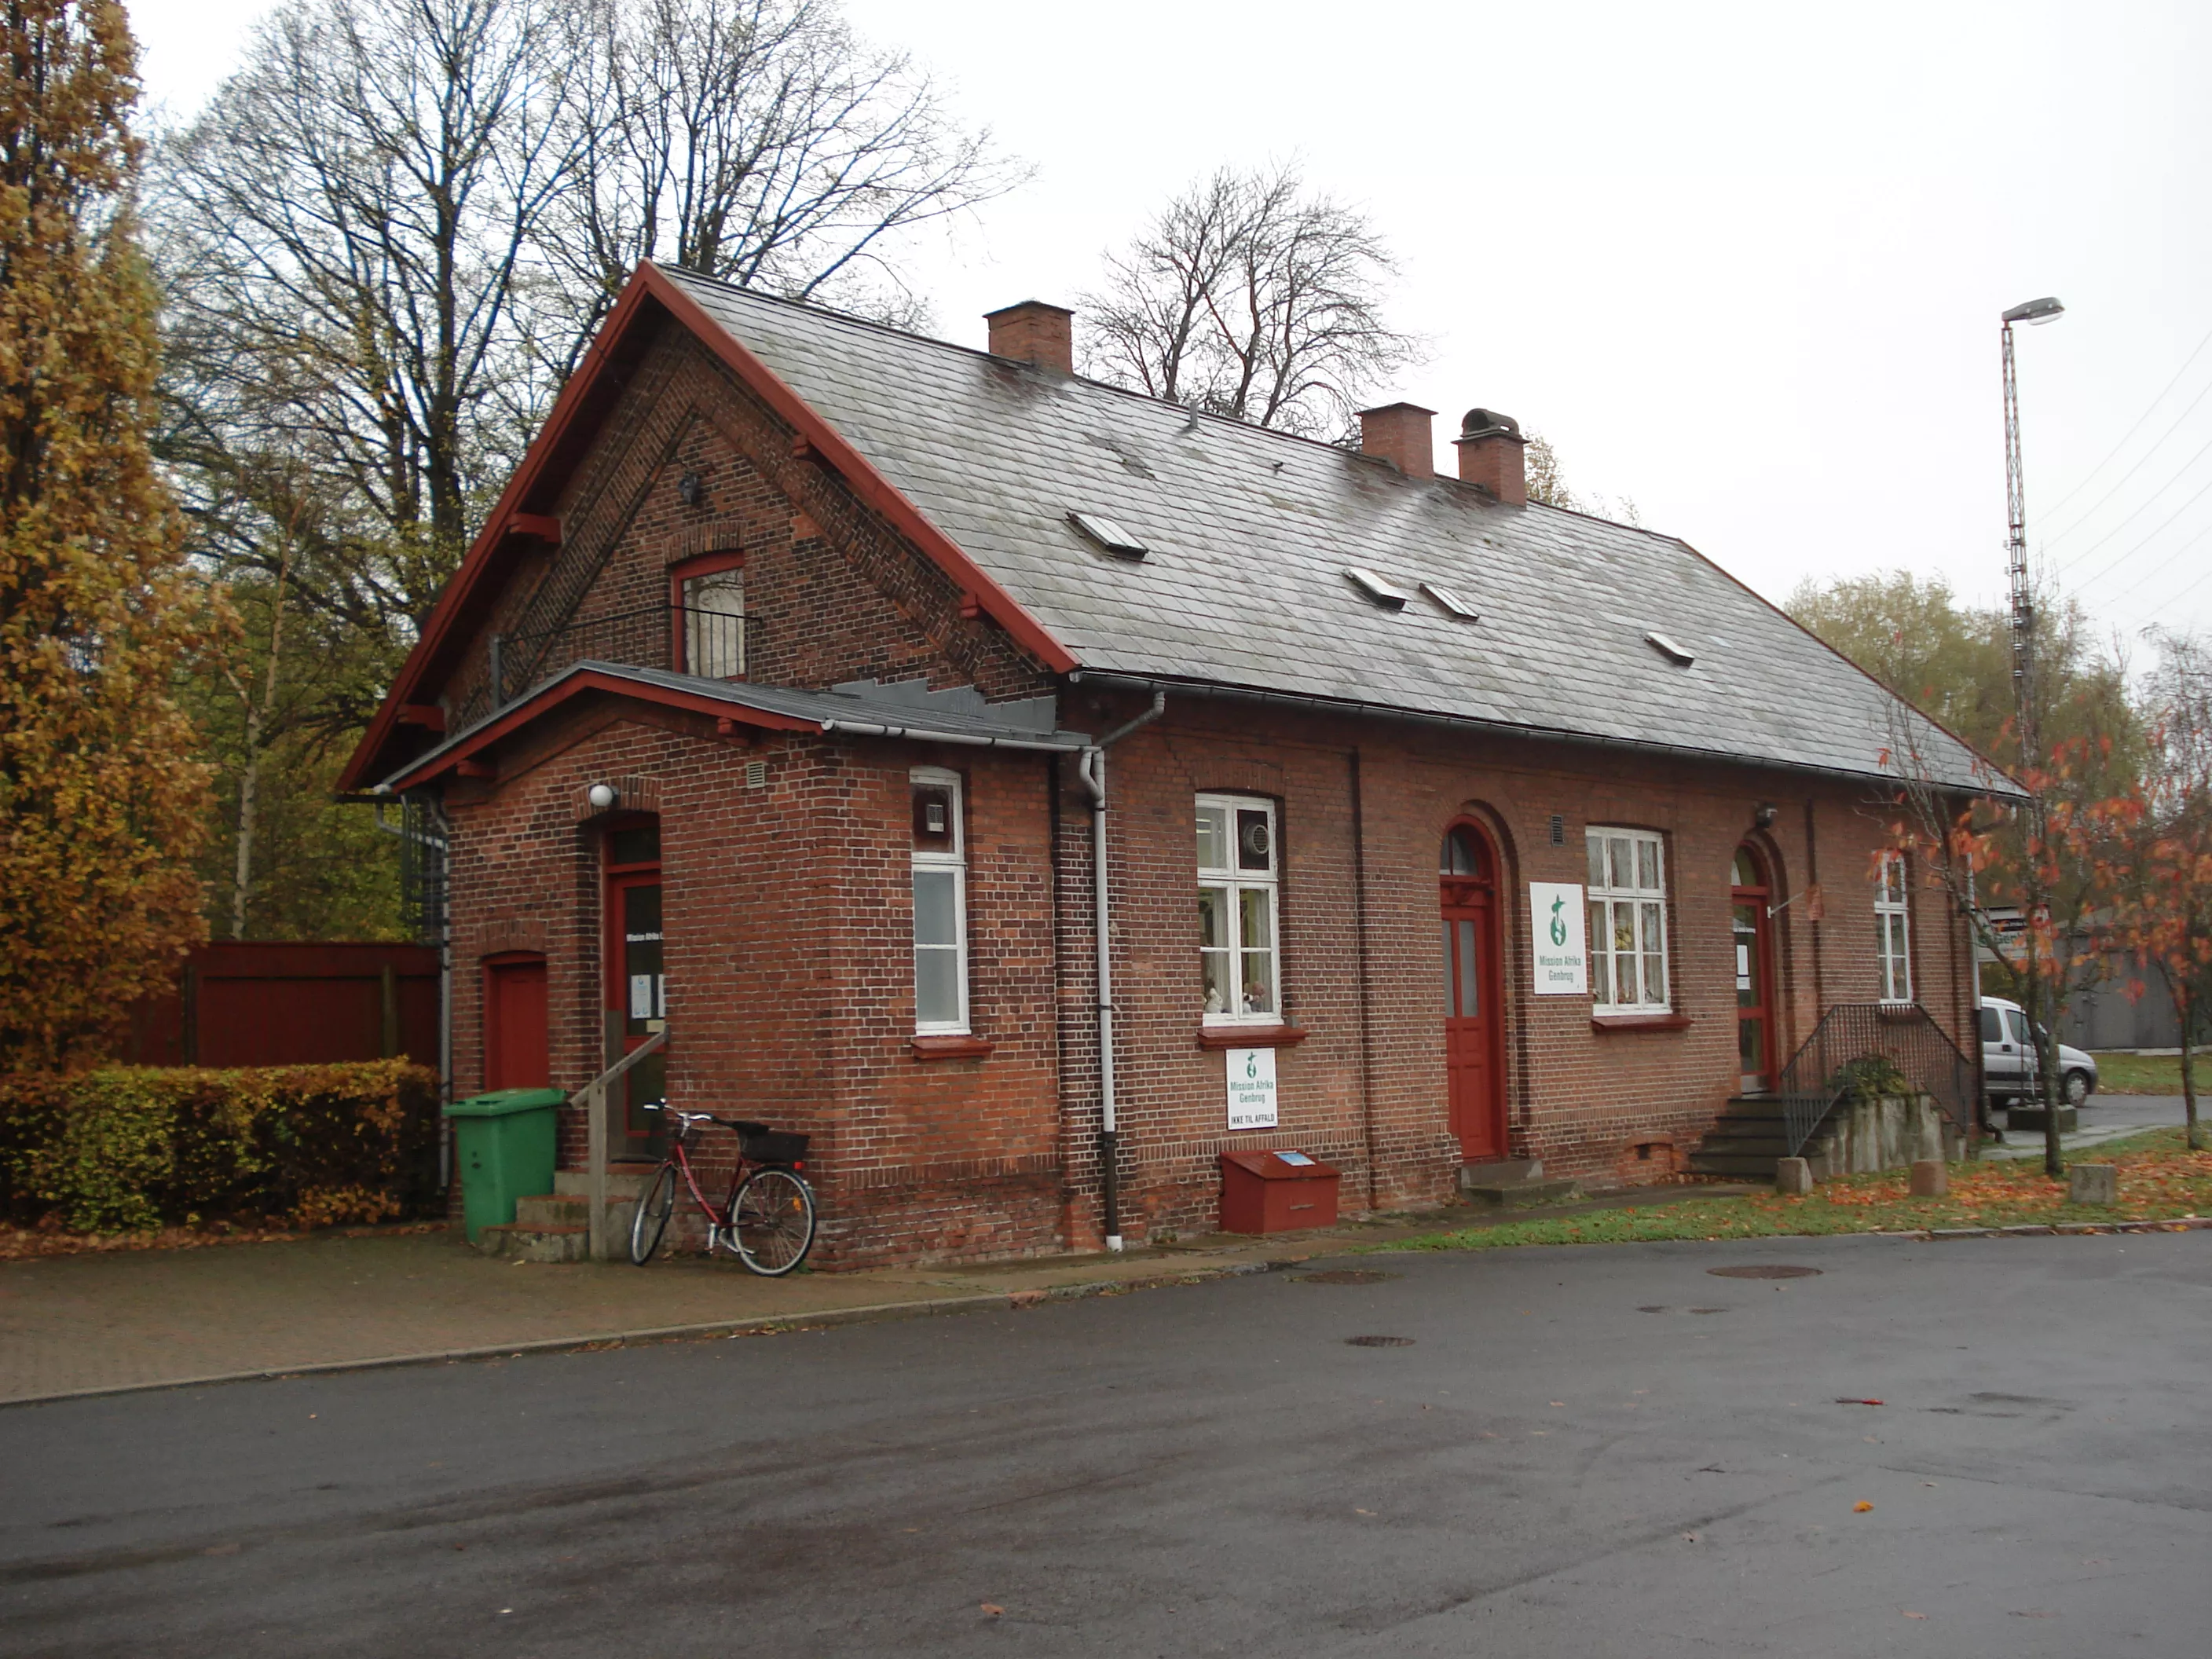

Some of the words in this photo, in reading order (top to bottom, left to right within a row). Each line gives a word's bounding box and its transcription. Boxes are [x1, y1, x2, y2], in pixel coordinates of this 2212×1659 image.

[1540, 955, 1562, 966] Mission
[1564, 955, 1581, 965] Afrika
[1548, 970, 1573, 983] Genbrug
[1230, 1082, 1254, 1091] Mission
[1256, 1080, 1273, 1090] Afrika
[1240, 1093, 1265, 1104] Genbrug
[1231, 1115, 1243, 1124] IKKE
[1255, 1113, 1274, 1122] AFFALD
